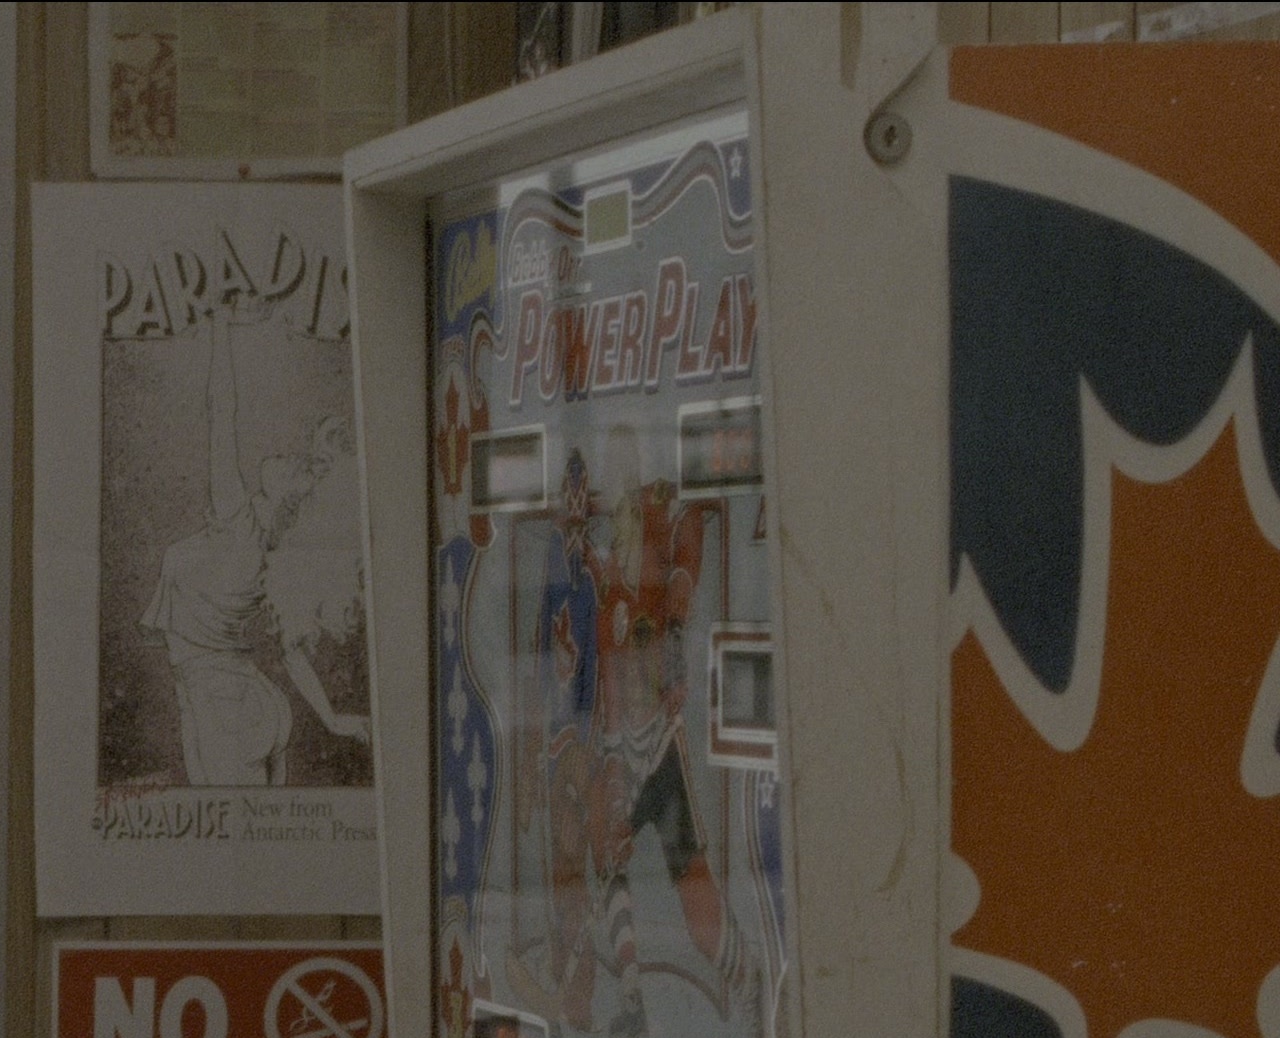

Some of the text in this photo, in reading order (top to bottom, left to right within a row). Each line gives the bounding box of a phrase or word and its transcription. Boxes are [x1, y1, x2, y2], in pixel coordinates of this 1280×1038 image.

[98, 228, 351, 338] PARADI
[99, 799, 229, 841] PARADISE
[241, 796, 333, 818] New from
